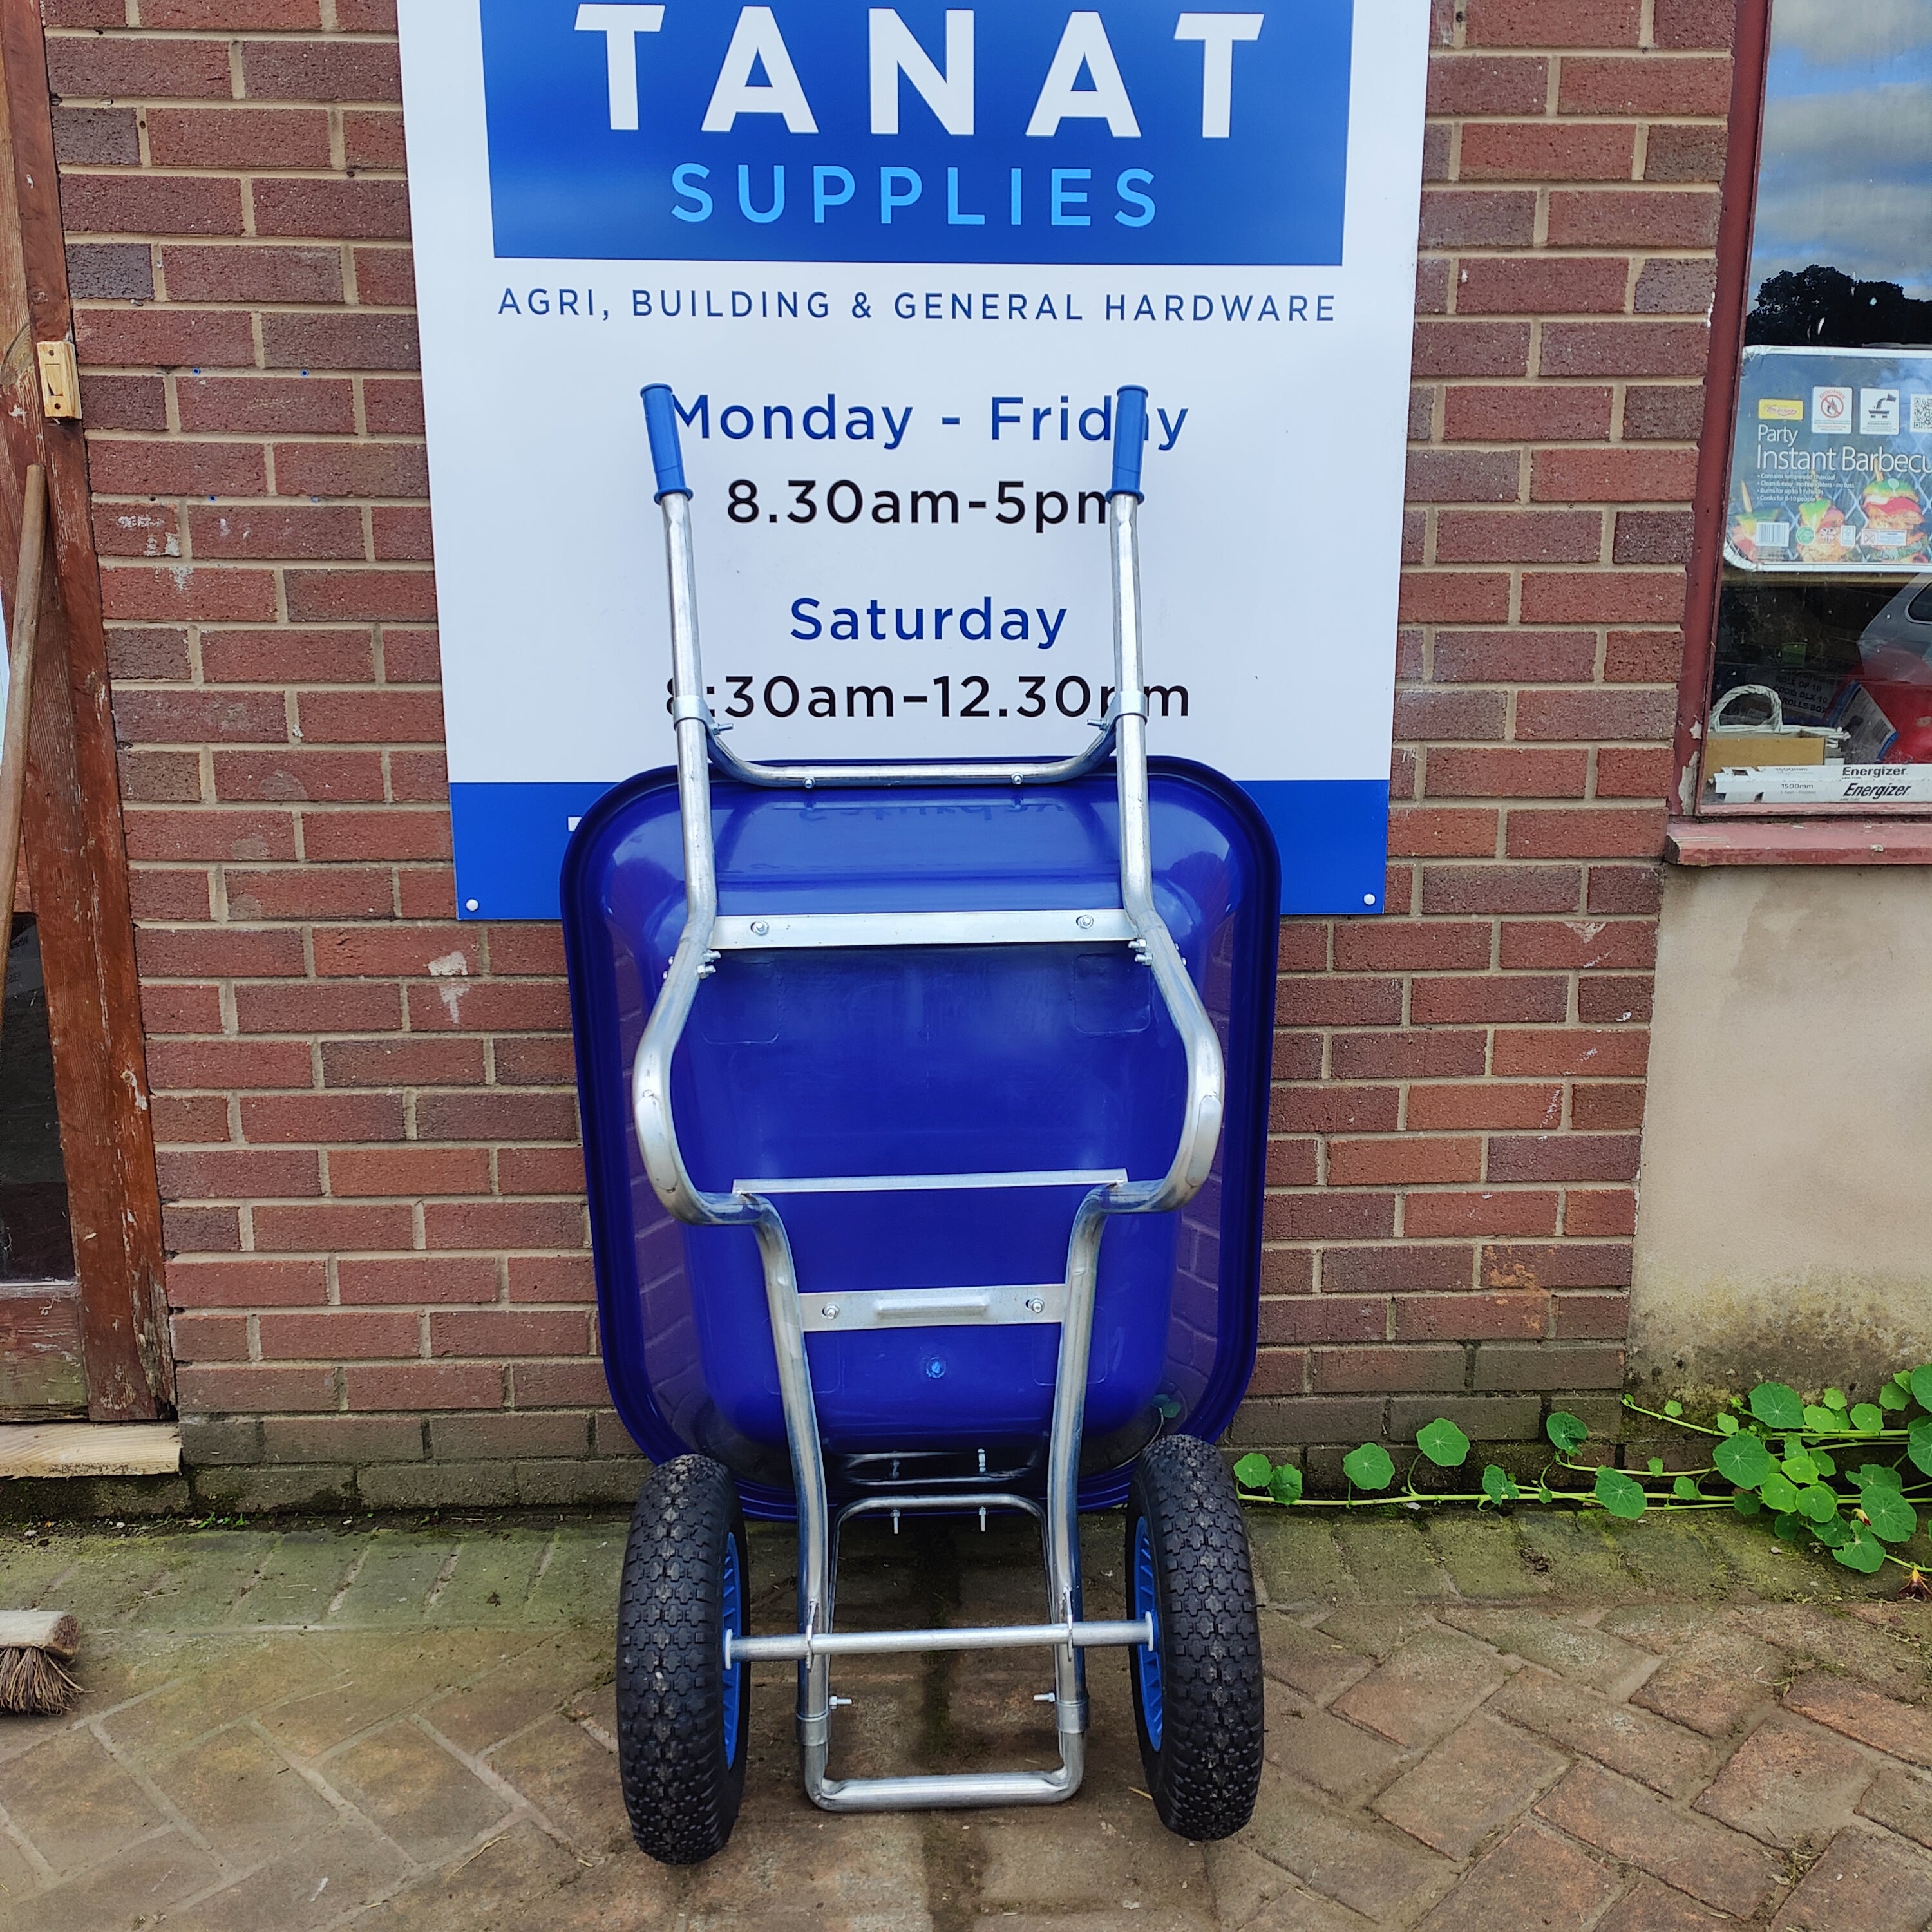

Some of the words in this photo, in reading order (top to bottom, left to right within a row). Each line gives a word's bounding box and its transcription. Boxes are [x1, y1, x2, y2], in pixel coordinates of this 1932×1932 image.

[574, 4, 1264, 137] TANAT
[672, 163, 1155, 227] SUPPLIES
[498, 287, 608, 321] AGRI,
[632, 289, 829, 319] BUILDING
[851, 292, 872, 319] &
[895, 292, 1083, 320] GENERAL
[1106, 294, 1334, 321] HARDWARE
[672, 393, 913, 450] Monday
[992, 395, 1189, 451] Fridy
[1758, 424, 1798, 447] Party
[1757, 444, 1836, 470] Instant
[791, 596, 1068, 650] Saturday
[1842, 766, 1907, 778] Energizer
[1843, 782, 1912, 800] Energizer
